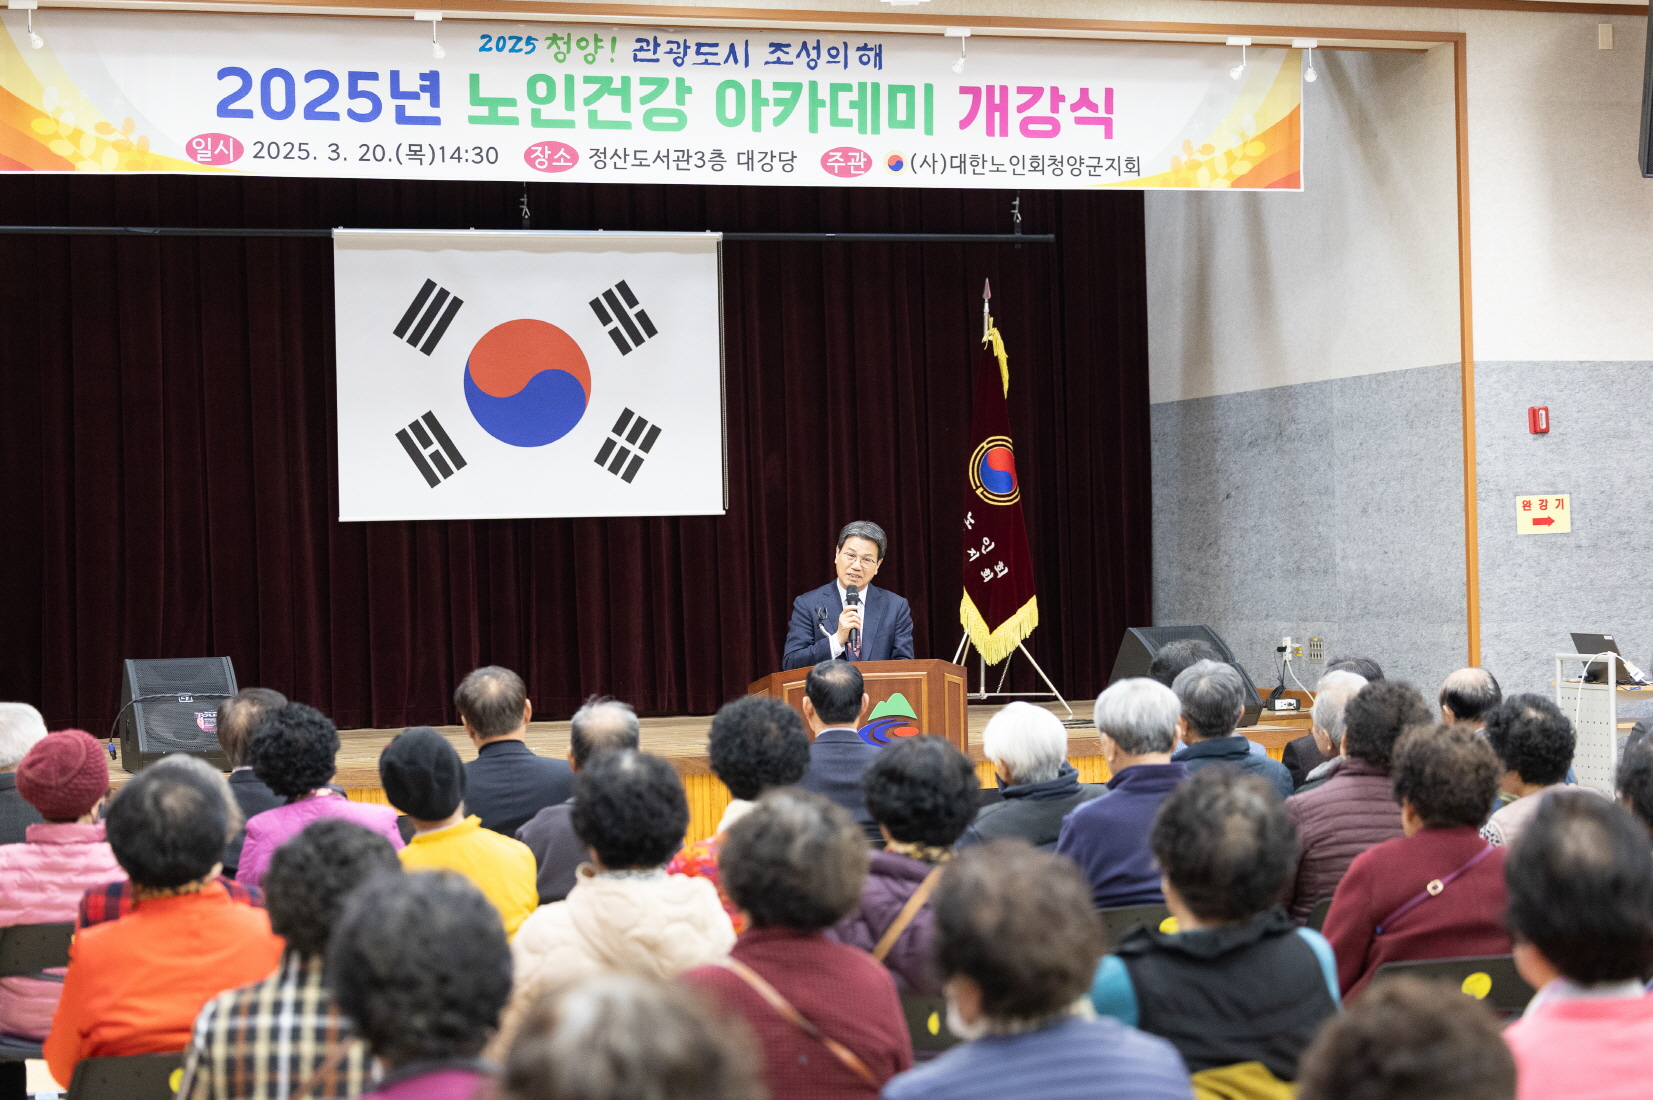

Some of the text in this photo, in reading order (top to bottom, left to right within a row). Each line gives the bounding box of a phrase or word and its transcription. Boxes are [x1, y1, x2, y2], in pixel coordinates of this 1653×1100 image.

[478, 34, 539, 55] 2025
[544, 32, 617, 65] 청양!
[632, 35, 749, 69] 관광도시
[216, 66, 1114, 140] 2025년 노인건강 아카데미 개강식
[192, 137, 235, 162] 일시
[252, 141, 317, 161] 2025.
[327, 143, 348, 162] 3.
[530, 145, 798, 173] 장소 정산도서관3층 대강당
[826, 151, 1142, 177] 주관 (사)대한노인회청양군지회
